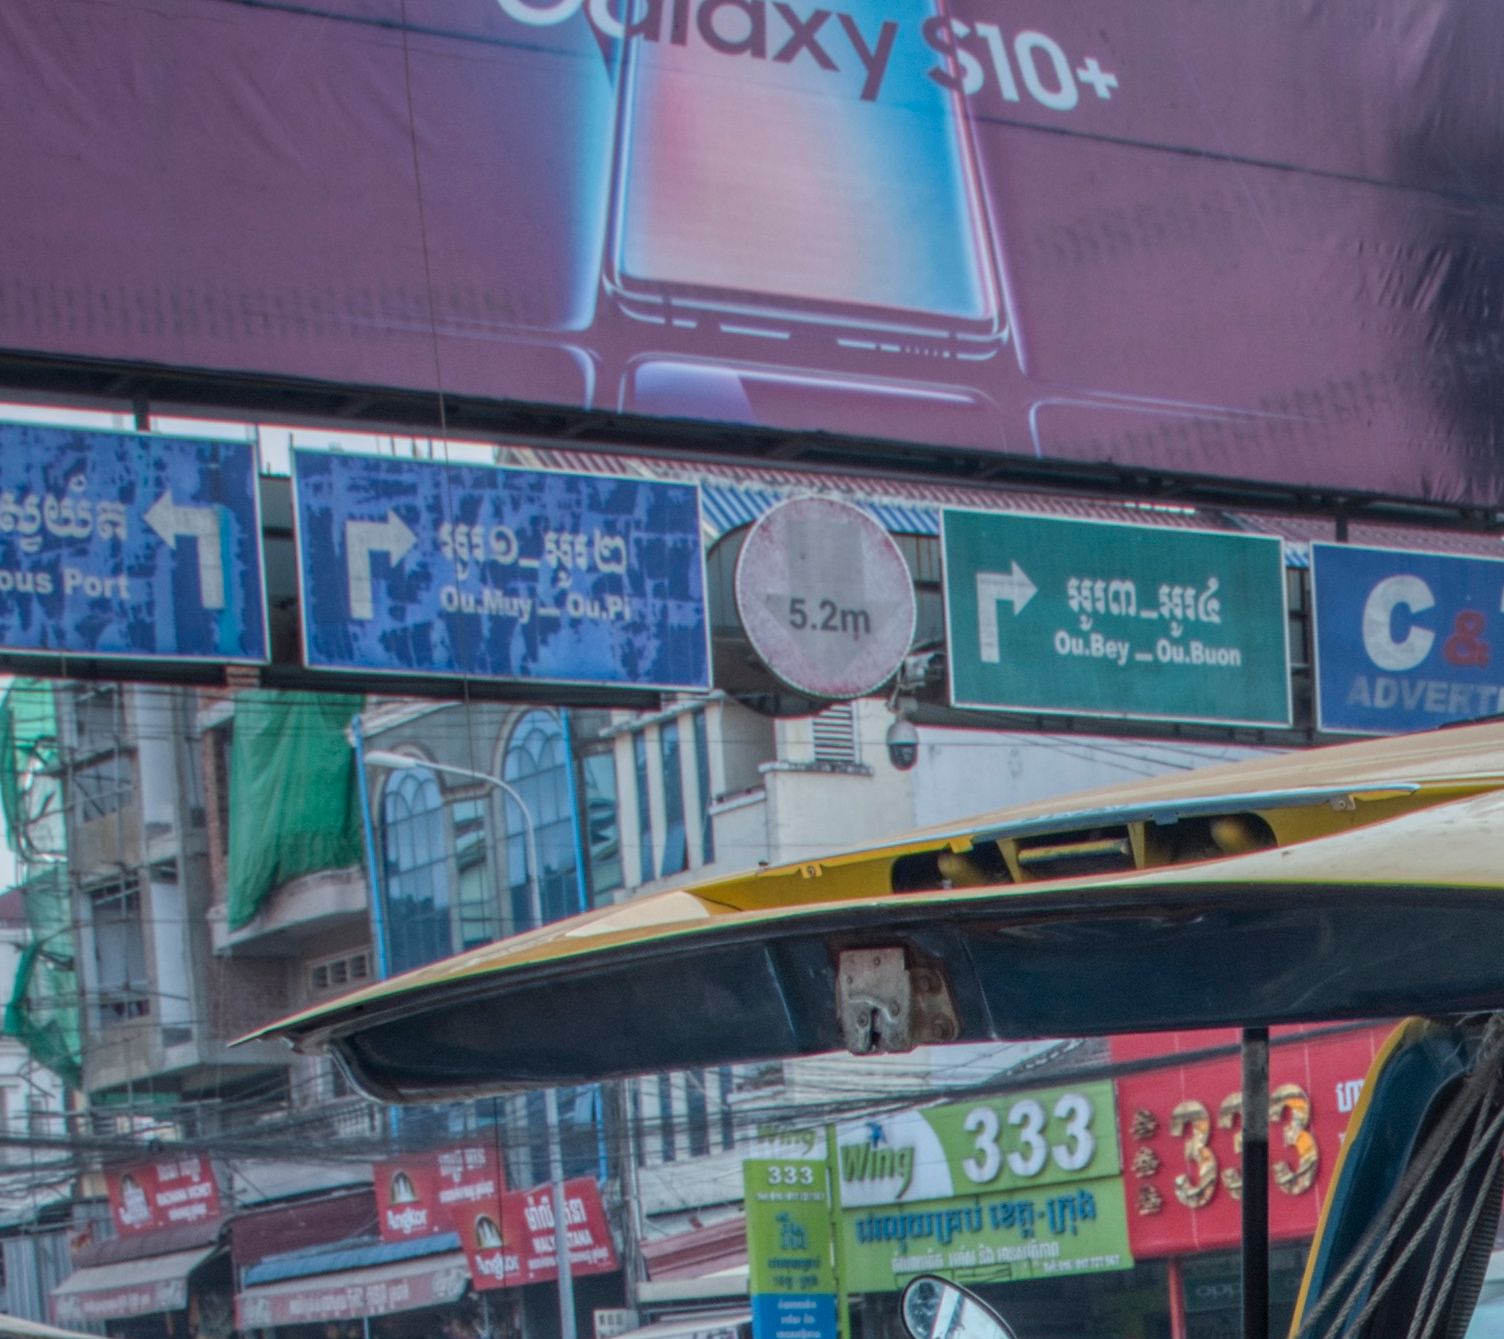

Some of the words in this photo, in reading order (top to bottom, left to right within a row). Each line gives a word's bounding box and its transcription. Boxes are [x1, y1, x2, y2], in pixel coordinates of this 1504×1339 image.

[922, 14, 1120, 111] S10+
[63, 567, 130, 600] Port
[1054, 631, 1129, 666] Ou.Bey
[1156, 638, 1242, 667] Ou.Buon
[963, 1092, 1096, 1184] 333
[767, 1165, 814, 1185] 333
[841, 1141, 915, 1200] Wing
